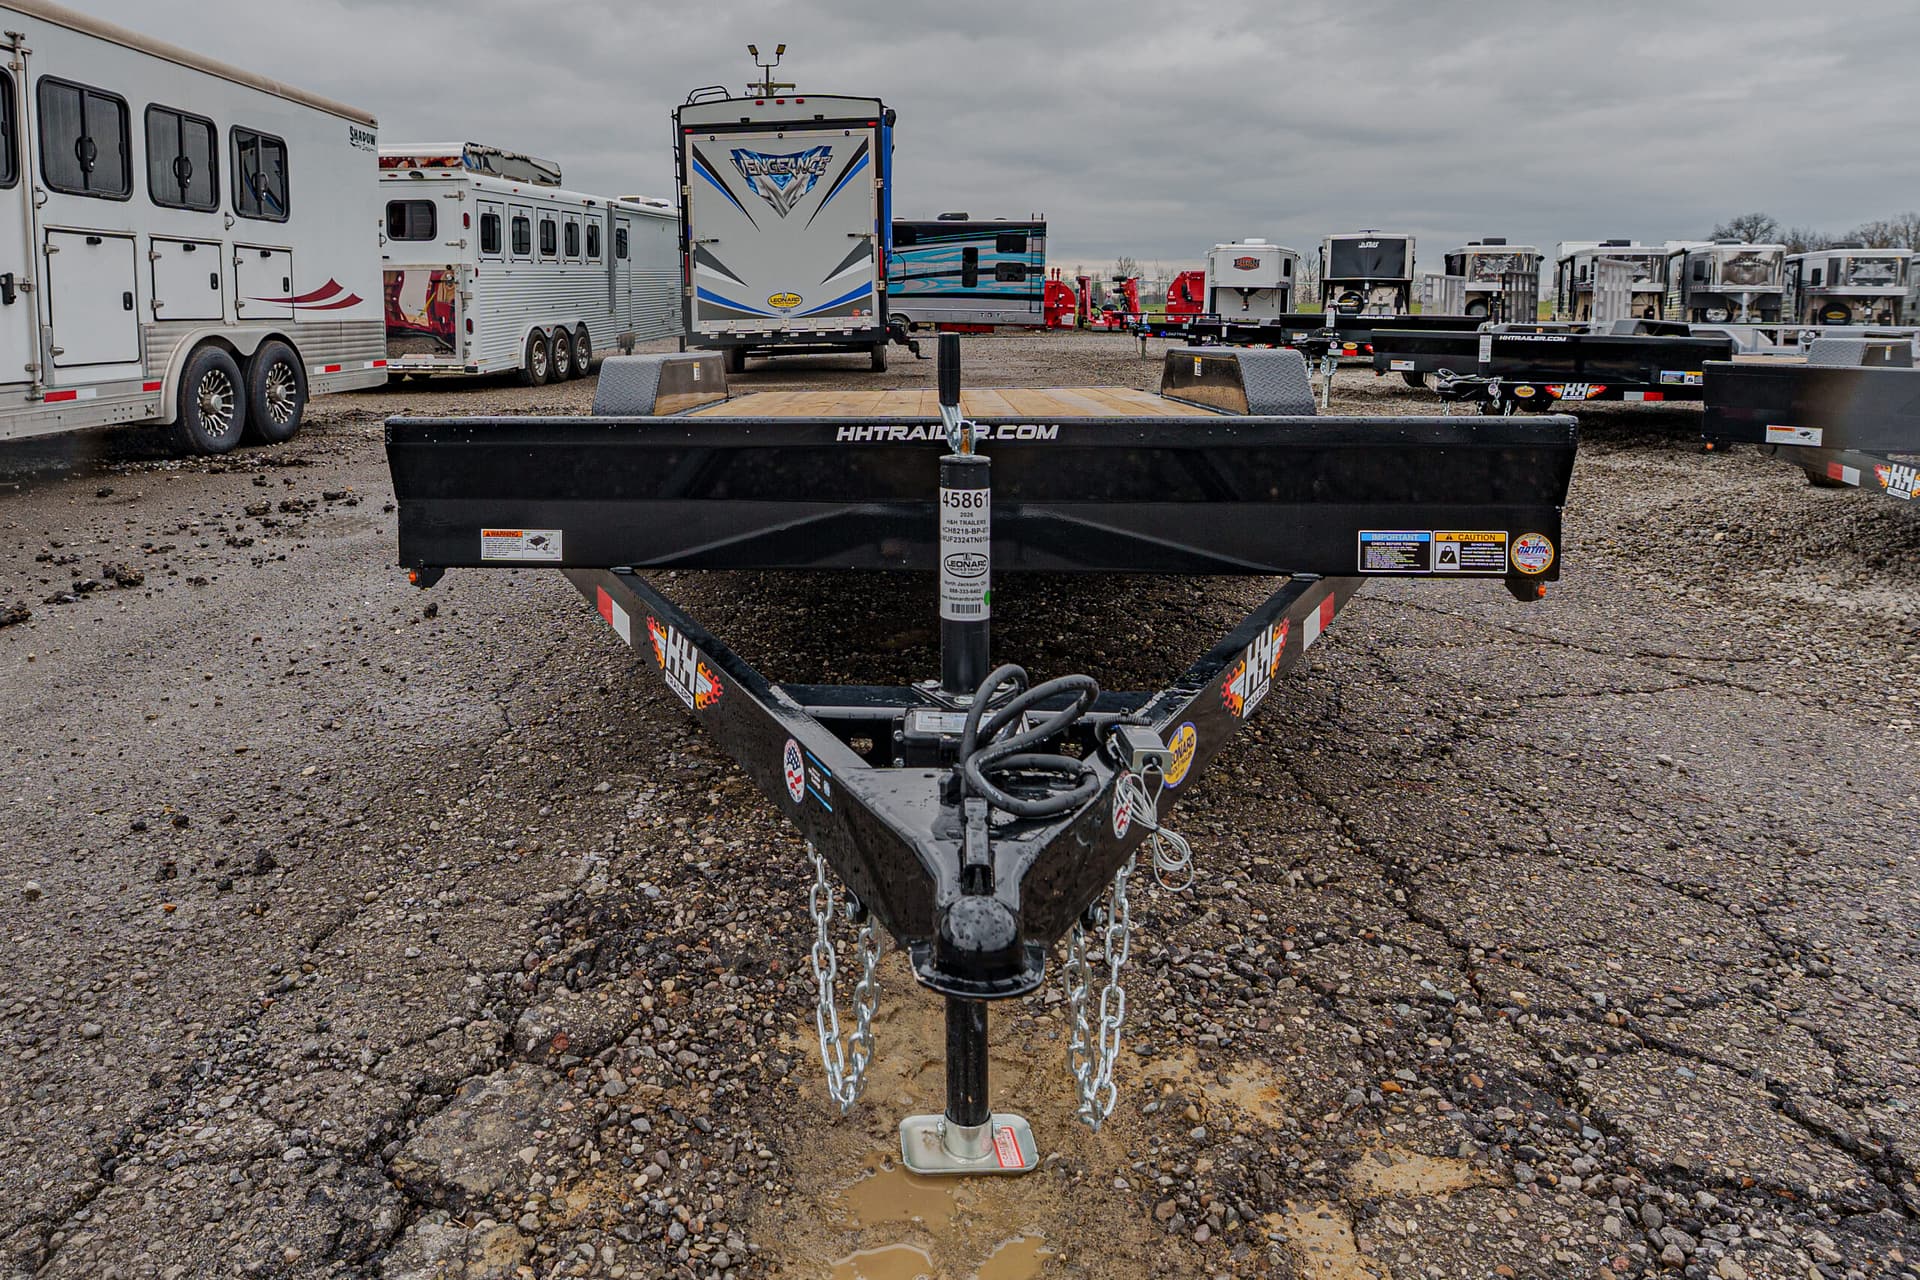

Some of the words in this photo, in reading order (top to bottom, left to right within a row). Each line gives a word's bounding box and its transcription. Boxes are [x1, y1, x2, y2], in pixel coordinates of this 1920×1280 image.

[729, 155, 833, 180] VENGEANCE
[836, 424, 1059, 441] HHTRAILR.COM
[942, 491, 989, 508] 45861
